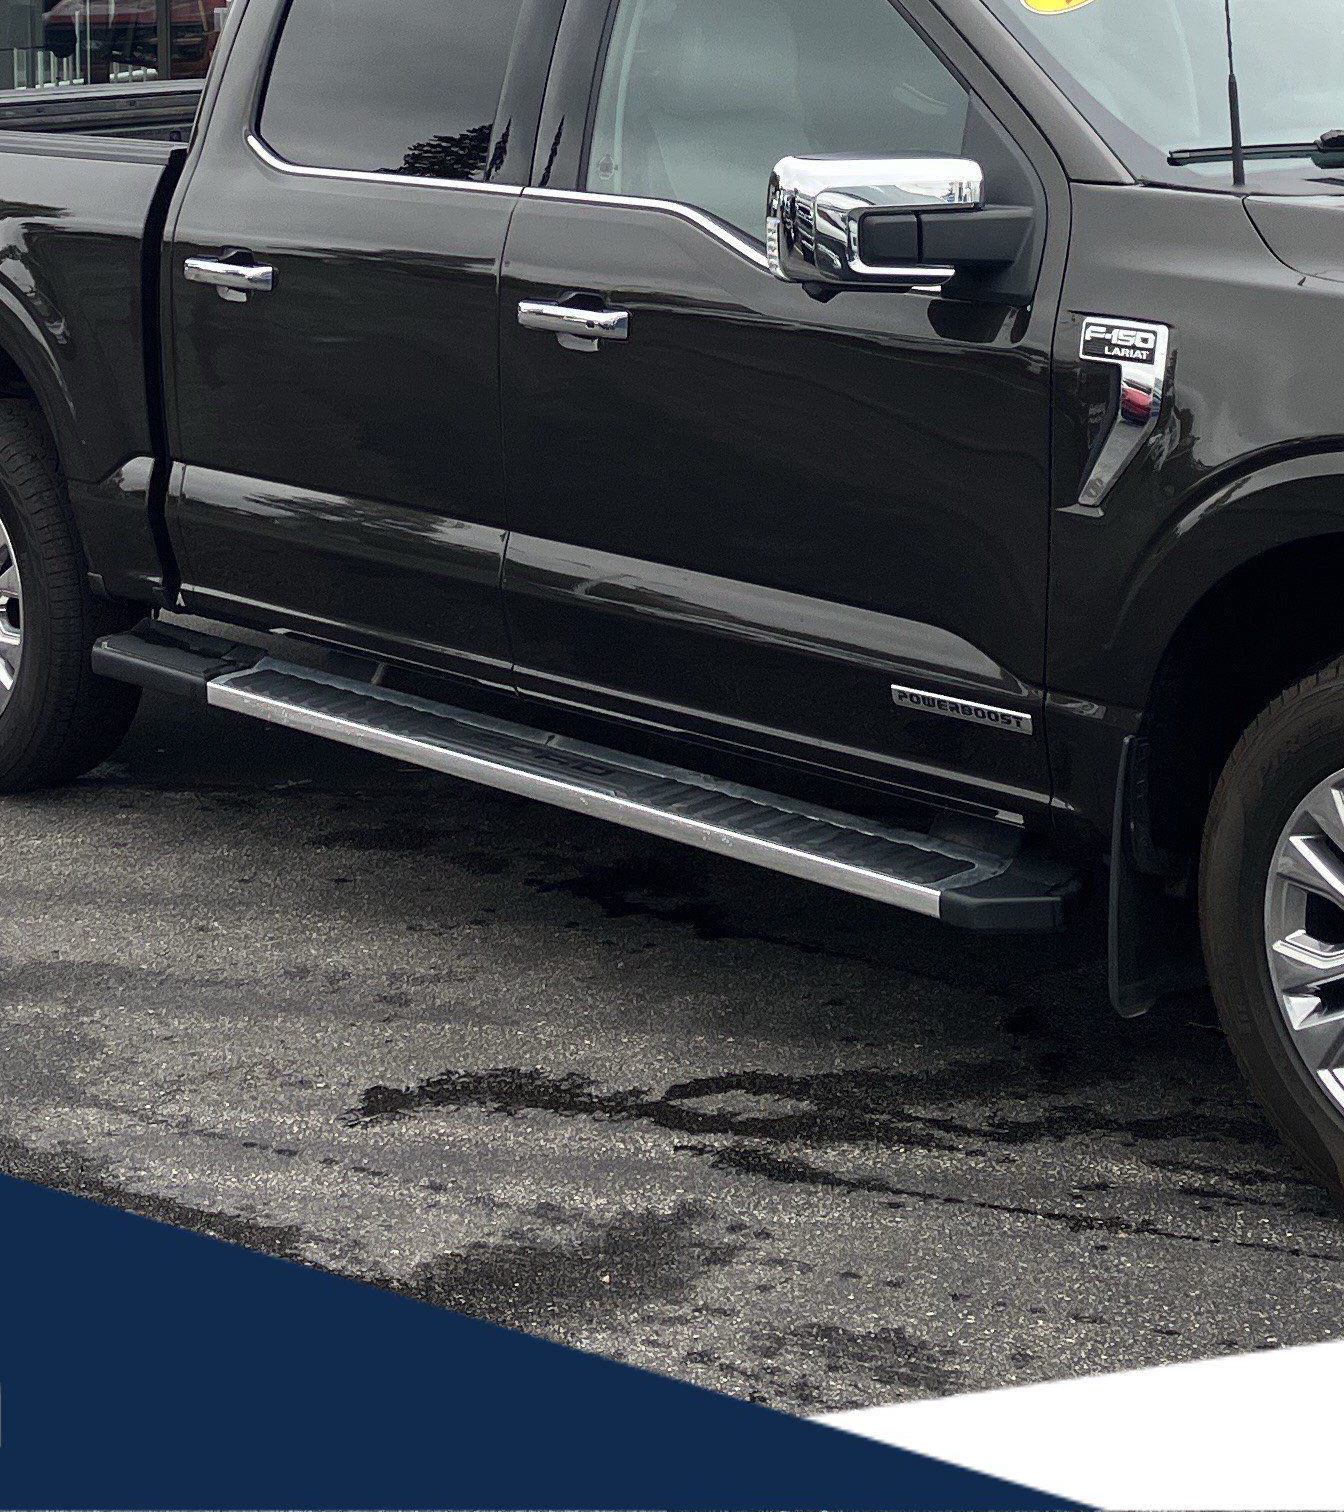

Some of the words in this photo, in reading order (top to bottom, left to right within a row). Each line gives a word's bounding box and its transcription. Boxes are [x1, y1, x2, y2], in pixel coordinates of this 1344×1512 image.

[1084, 324, 1156, 350] F-150
[1104, 345, 1151, 361] LARIAT
[896, 690, 1024, 729] POWERBOOST
